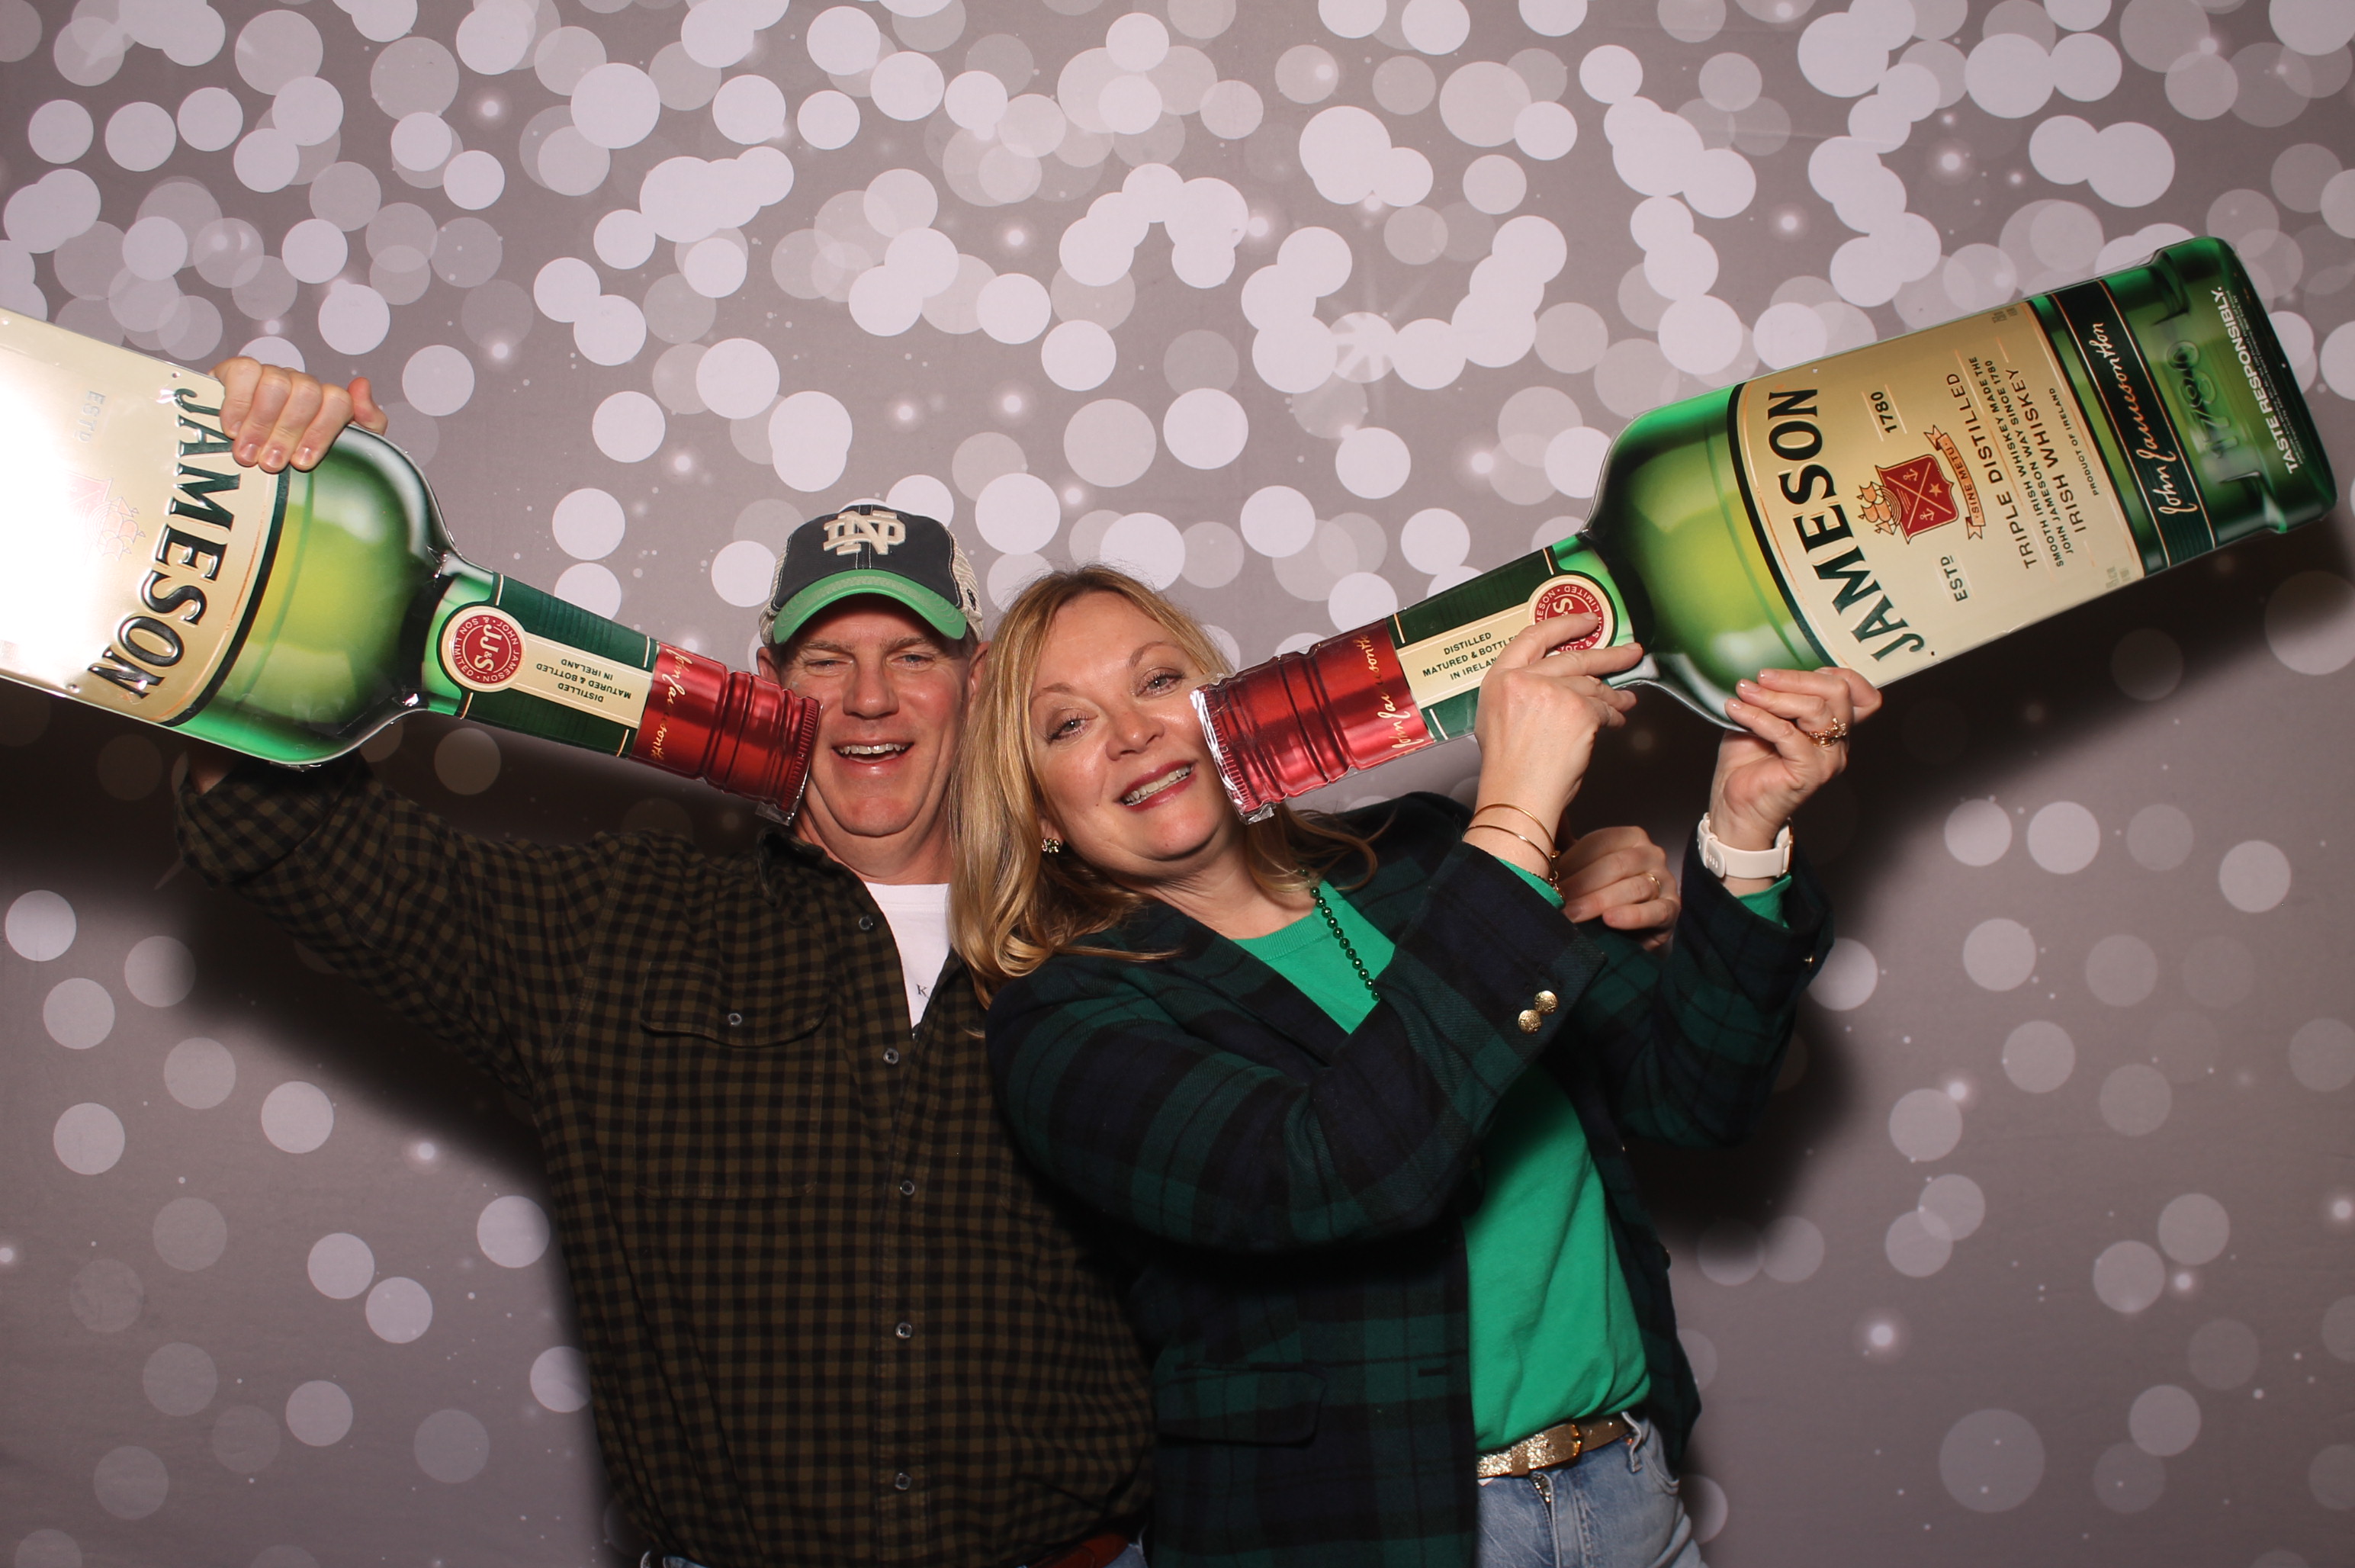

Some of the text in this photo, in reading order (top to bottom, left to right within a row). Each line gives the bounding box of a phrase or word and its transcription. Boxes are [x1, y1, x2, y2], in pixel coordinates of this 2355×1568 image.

[2210, 285, 2273, 413] RESPONSIBLY.
[1869, 390, 1898, 434] 1780
[2108, 357, 2176, 461] Jameson
[2167, 338, 2239, 458] 1780
[1945, 371, 2038, 568] TRIPLE DISTILLED
[1968, 356, 2064, 567] SMOOTH IRISH WHISKEY MADE THE
[1984, 358, 2074, 555] JOHN JAMESON WAY SINCE 1780
[2005, 365, 2087, 533] IRISH WHISKEY
[2048, 387, 2100, 496] PRODUCT OF IRELAND
[2265, 414, 2298, 474] TASTE
[1945, 445, 1980, 514] SINE METU
[2152, 464, 2197, 514] John
[87, 388, 241, 699] JAMESON
[1767, 389, 1925, 661] JAMESON
[459, 618, 479, 635] SON
[1563, 586, 1600, 612] LIMITED
[453, 637, 474, 676] LIMITED
[483, 622, 520, 682] JOHN JAMESON
[536, 663, 577, 682] BOTTLED
[561, 658, 613, 681] IN IRELAND
[1423, 654, 1468, 677] MATURED
[1478, 635, 1518, 656] BOTTL
[1444, 631, 1492, 655] DISTILLED
[557, 683, 604, 703] DISTILLED
[588, 680, 631, 699] MATURED
[1450, 670, 1460, 680] IN
